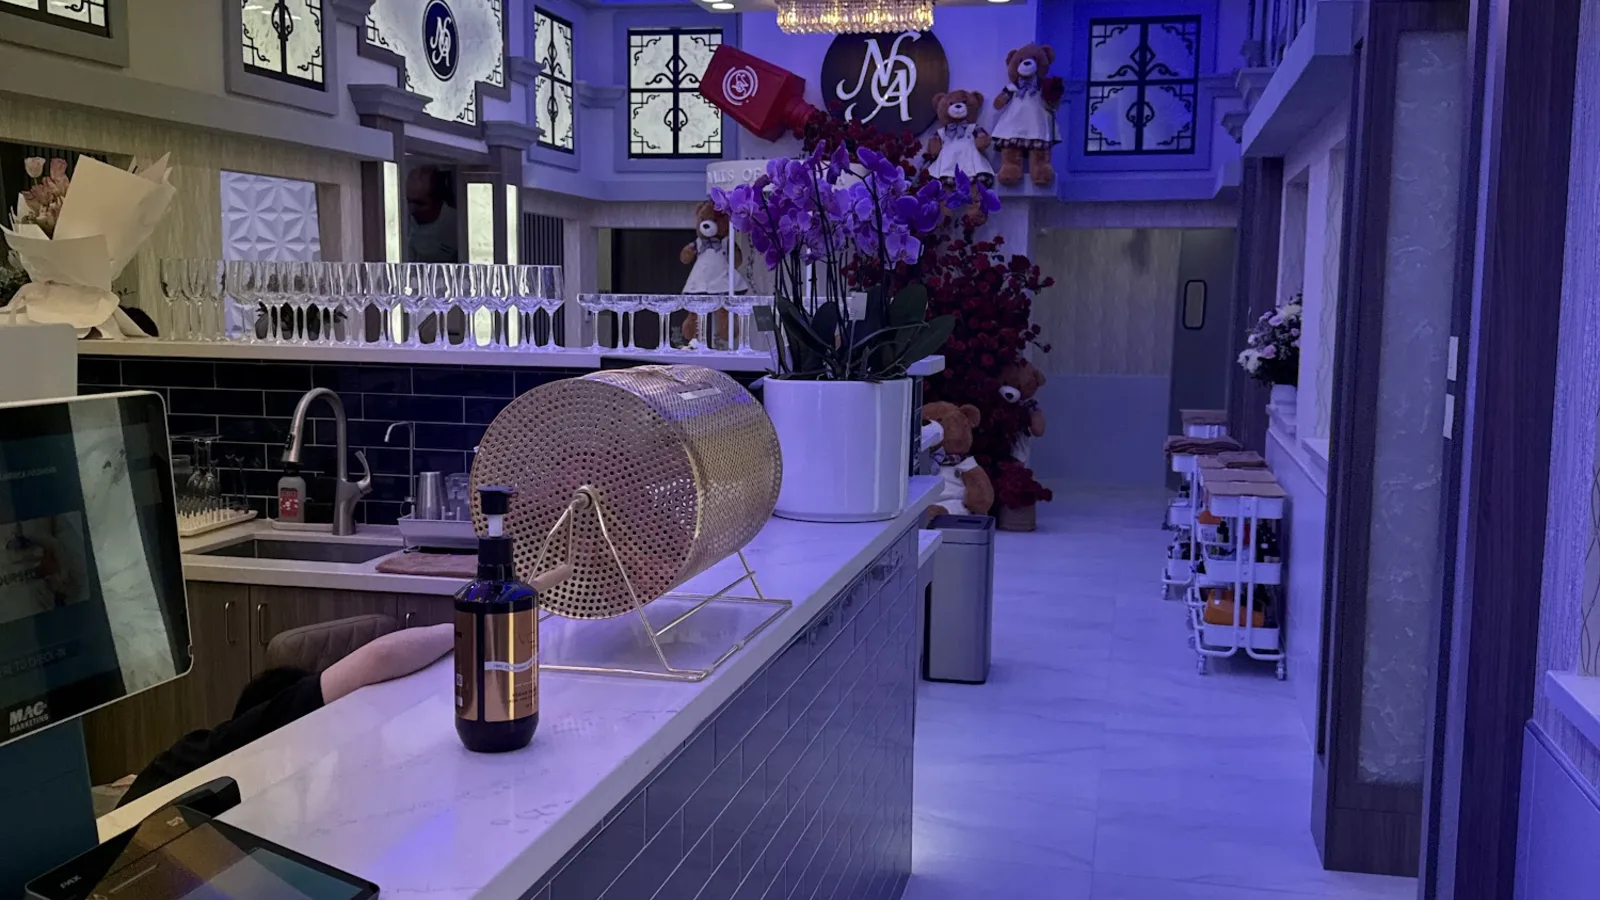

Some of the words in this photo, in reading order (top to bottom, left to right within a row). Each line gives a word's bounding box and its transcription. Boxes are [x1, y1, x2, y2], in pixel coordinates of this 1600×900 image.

[9, 701, 45, 726] MAC
[9, 713, 49, 734] MARKETING
[60, 875, 82, 889] PAX
